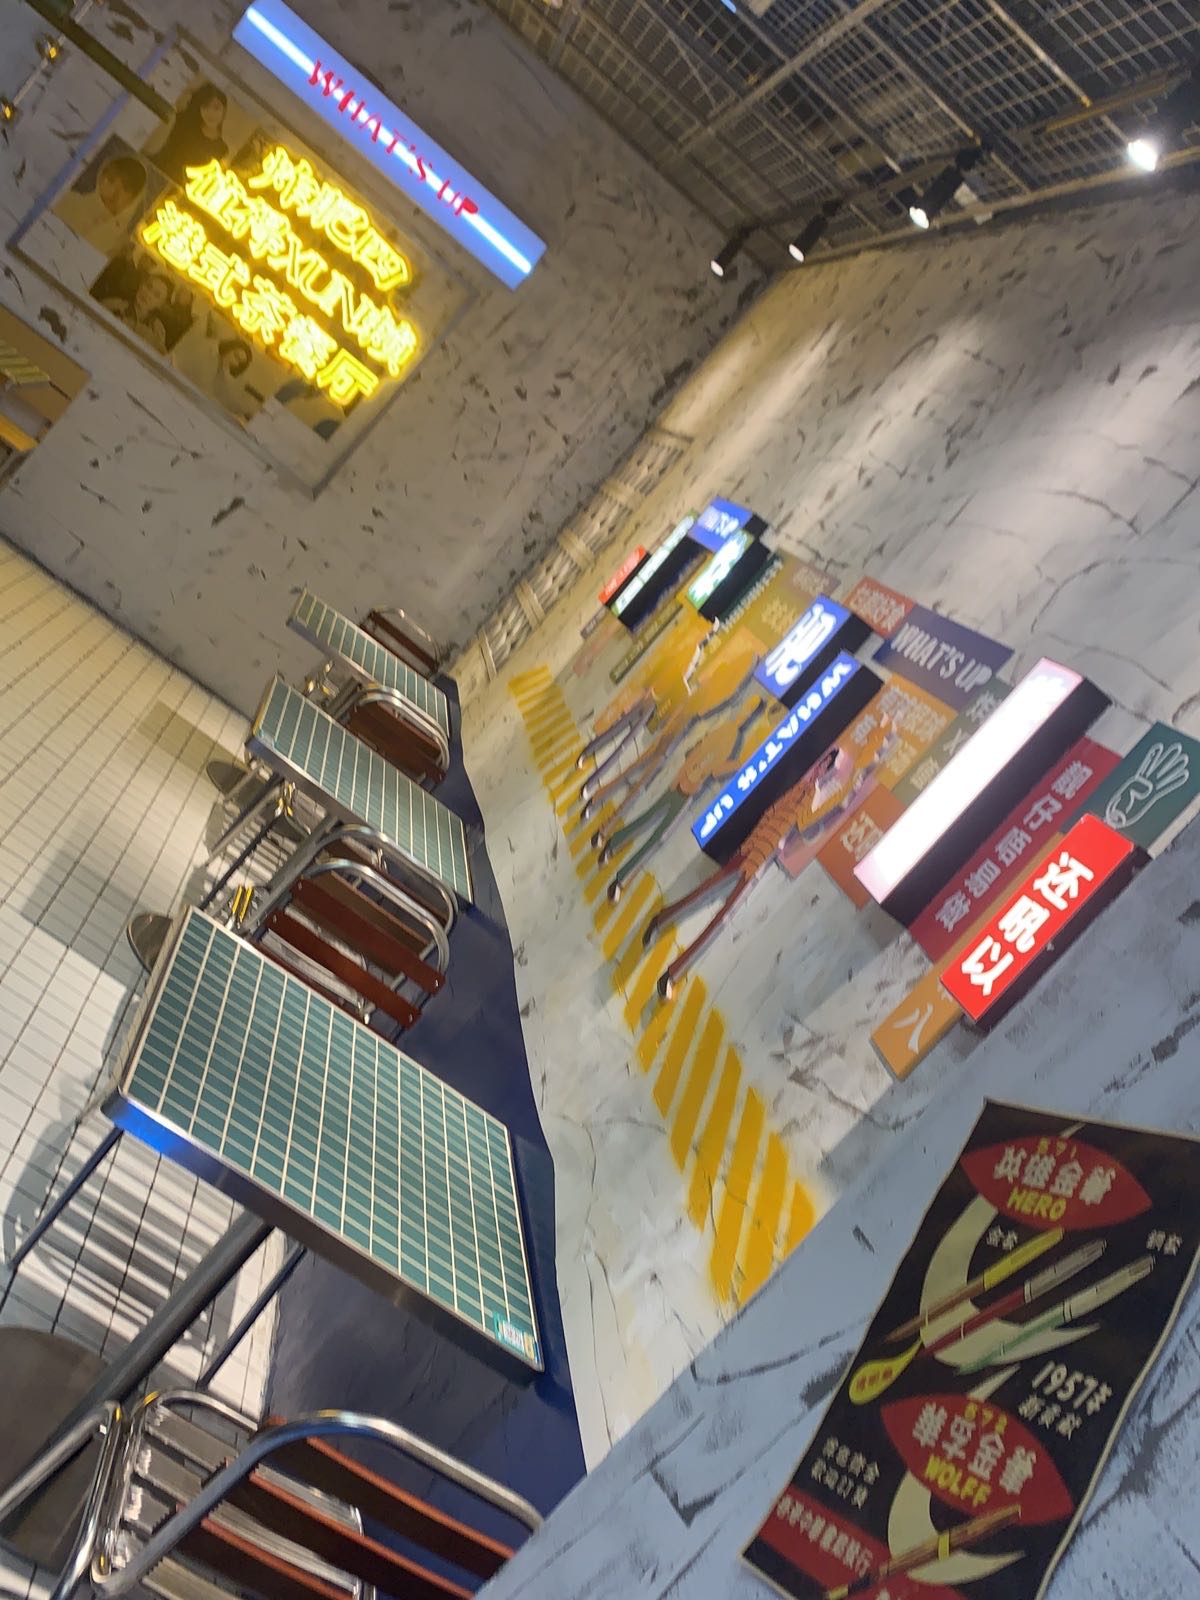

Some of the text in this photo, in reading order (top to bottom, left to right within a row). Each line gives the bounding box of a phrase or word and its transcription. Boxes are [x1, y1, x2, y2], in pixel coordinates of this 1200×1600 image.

[308, 60, 479, 216] WHAT'S UP
[142, 200, 379, 405] 港式茶餐厅
[891, 622, 992, 693] WHAT'S UP
[737, 662, 852, 791] WHAT'S
[700, 794, 734, 838] UP
[1007, 1186, 1067, 1222] HERO
[924, 1453, 992, 1508] WOLFF
